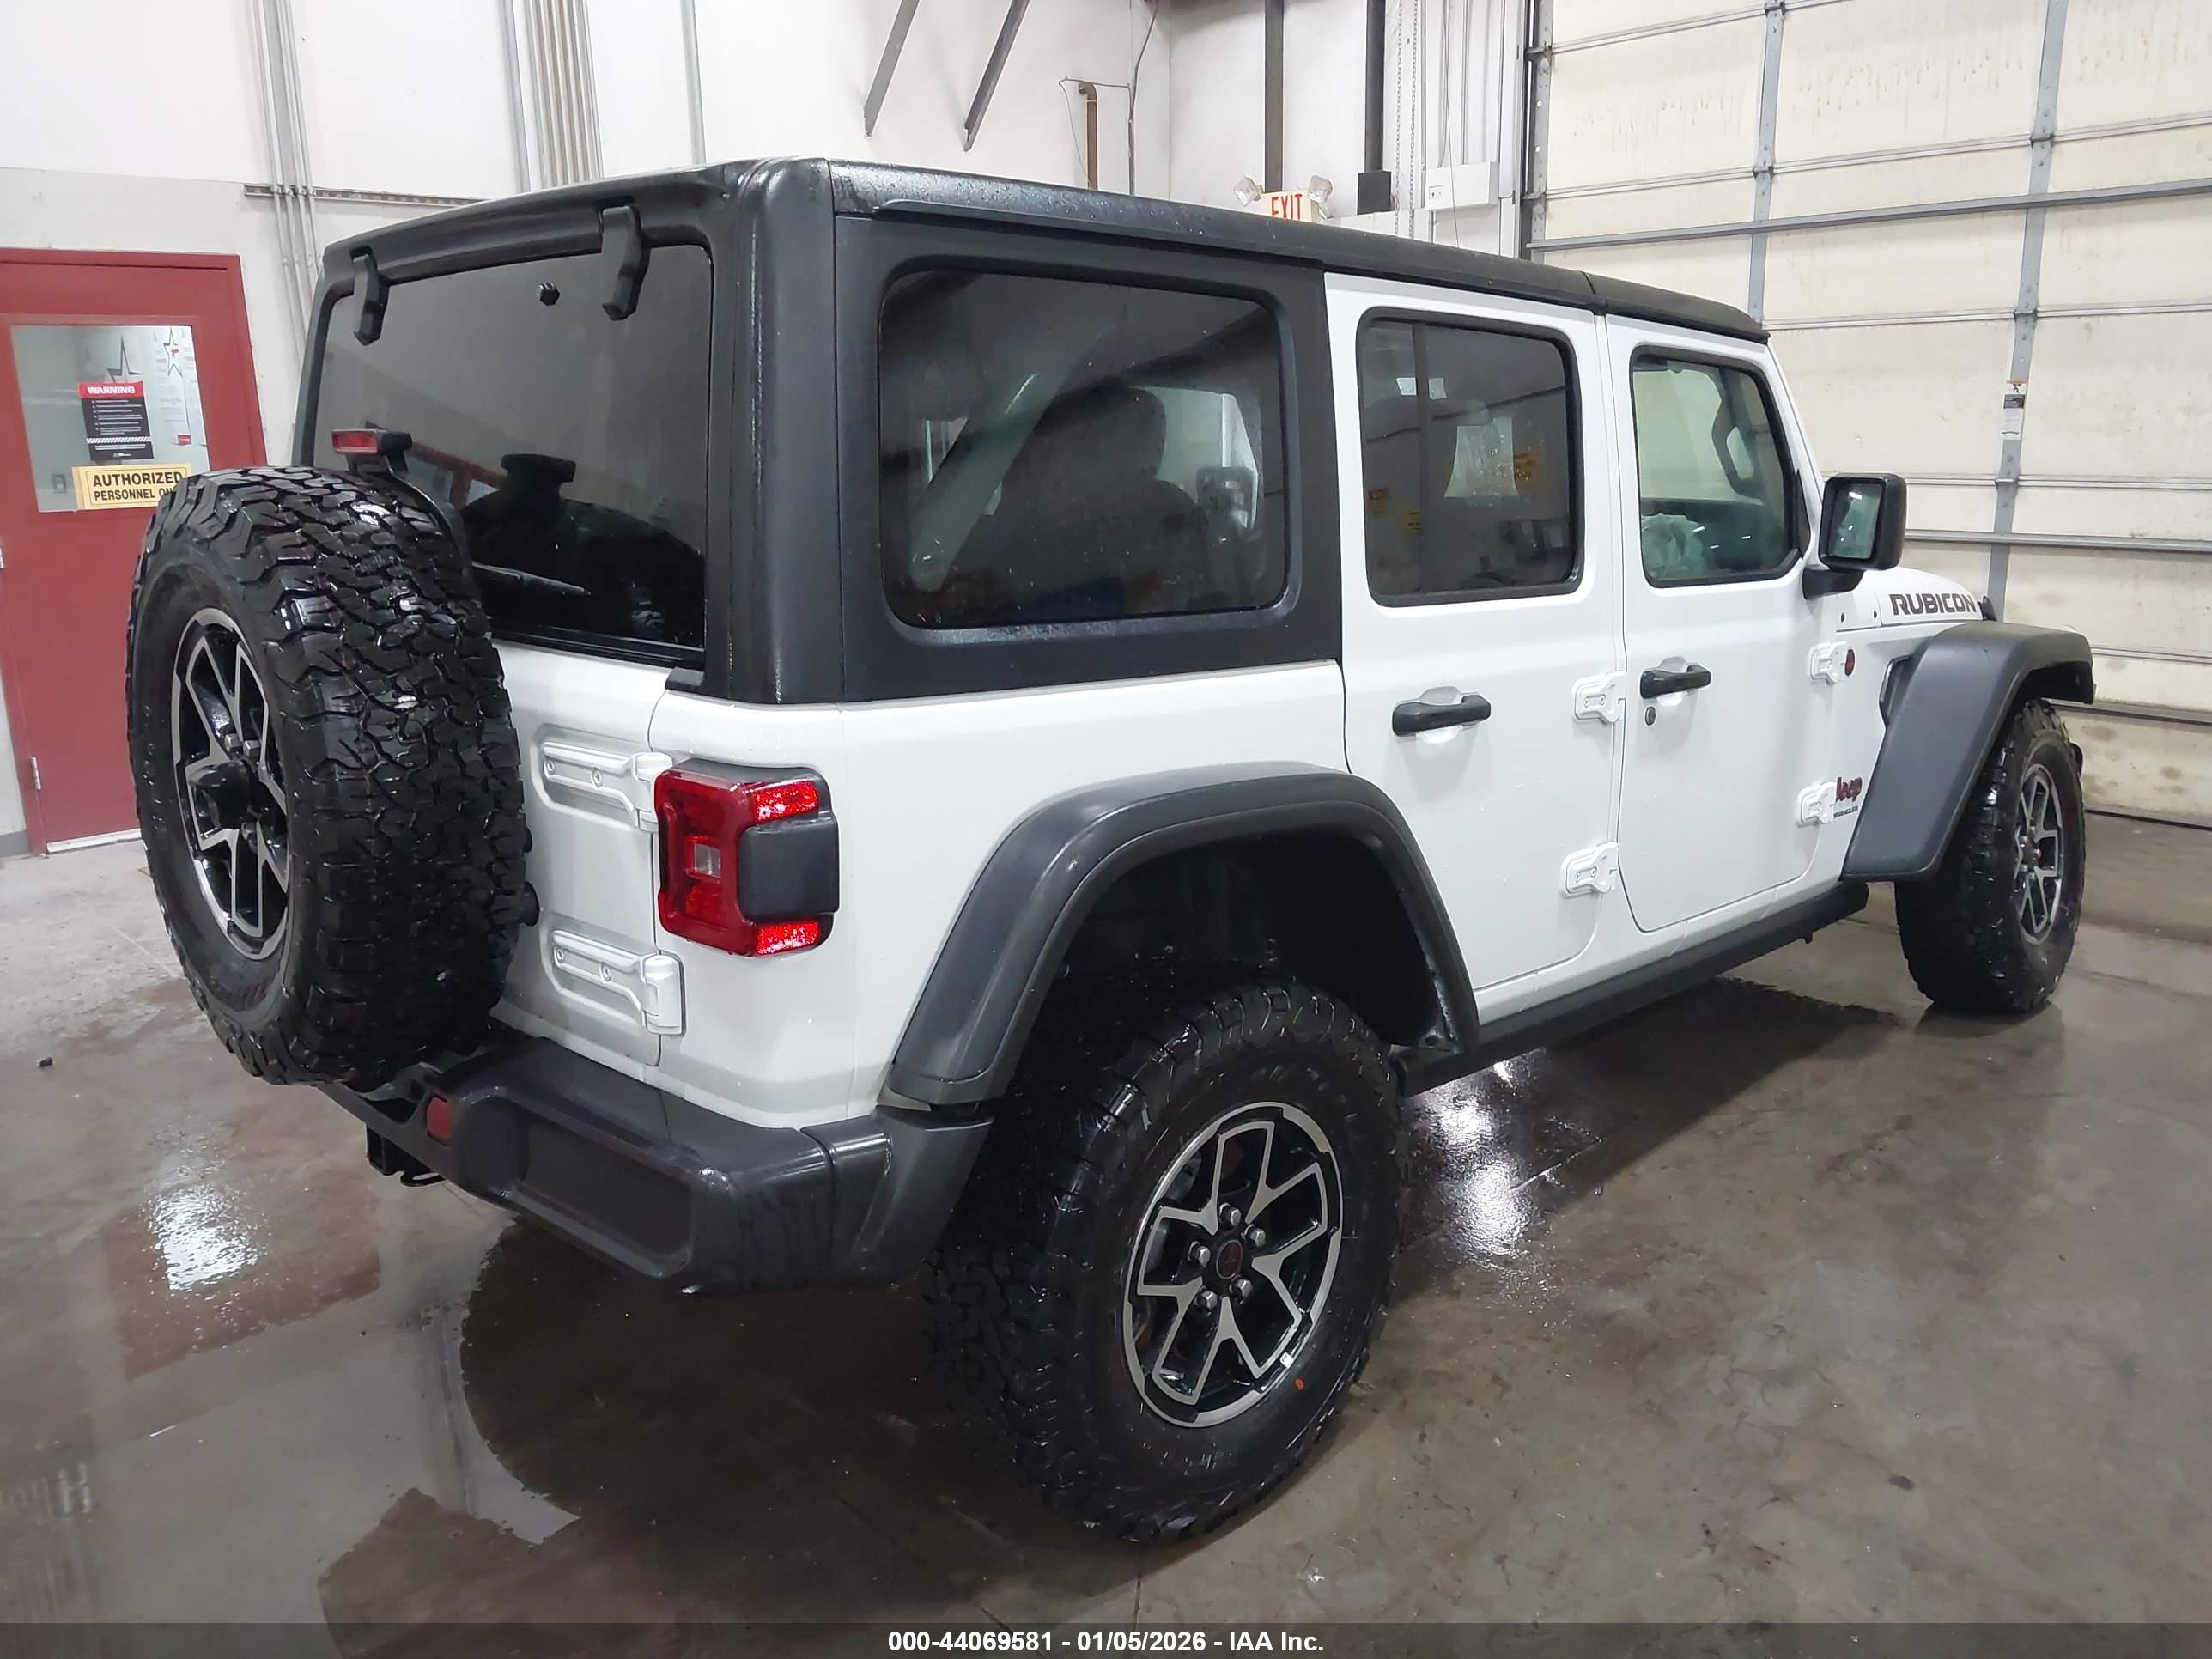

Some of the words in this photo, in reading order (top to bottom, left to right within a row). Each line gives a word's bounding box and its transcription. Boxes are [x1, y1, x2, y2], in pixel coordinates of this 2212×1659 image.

[1271, 193, 1303, 221] EXIT
[87, 386, 136, 394] WARNING
[93, 471, 183, 487] AUTHORIZED
[94, 488, 155, 501] PERSONNEL
[1889, 593, 1976, 616] RUBICON
